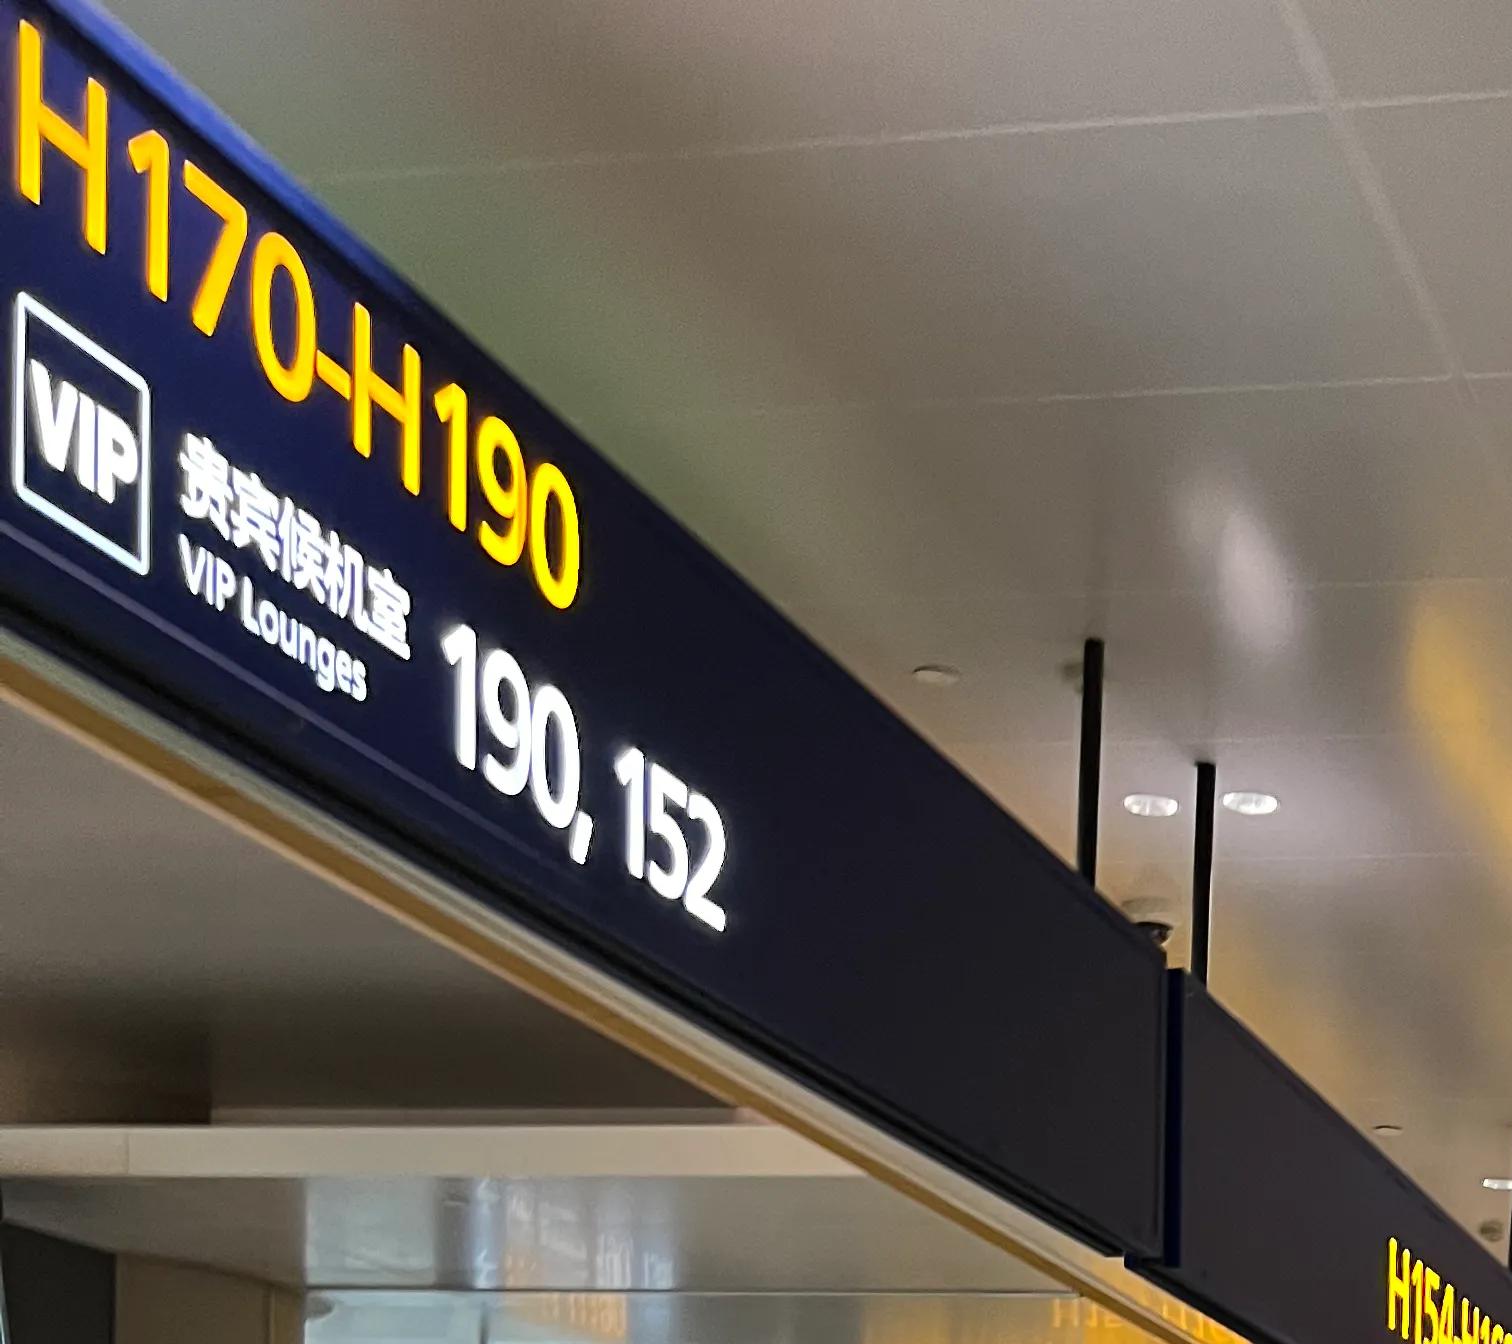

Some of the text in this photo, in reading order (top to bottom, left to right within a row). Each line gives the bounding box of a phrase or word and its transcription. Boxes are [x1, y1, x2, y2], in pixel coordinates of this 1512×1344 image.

[15, 20, 580, 610] H170-H190
[30, 358, 138, 504] VIP
[177, 432, 411, 662] 贵宾候机室
[178, 532, 368, 702] VIP Lounges
[440, 624, 727, 932] 190, 152
